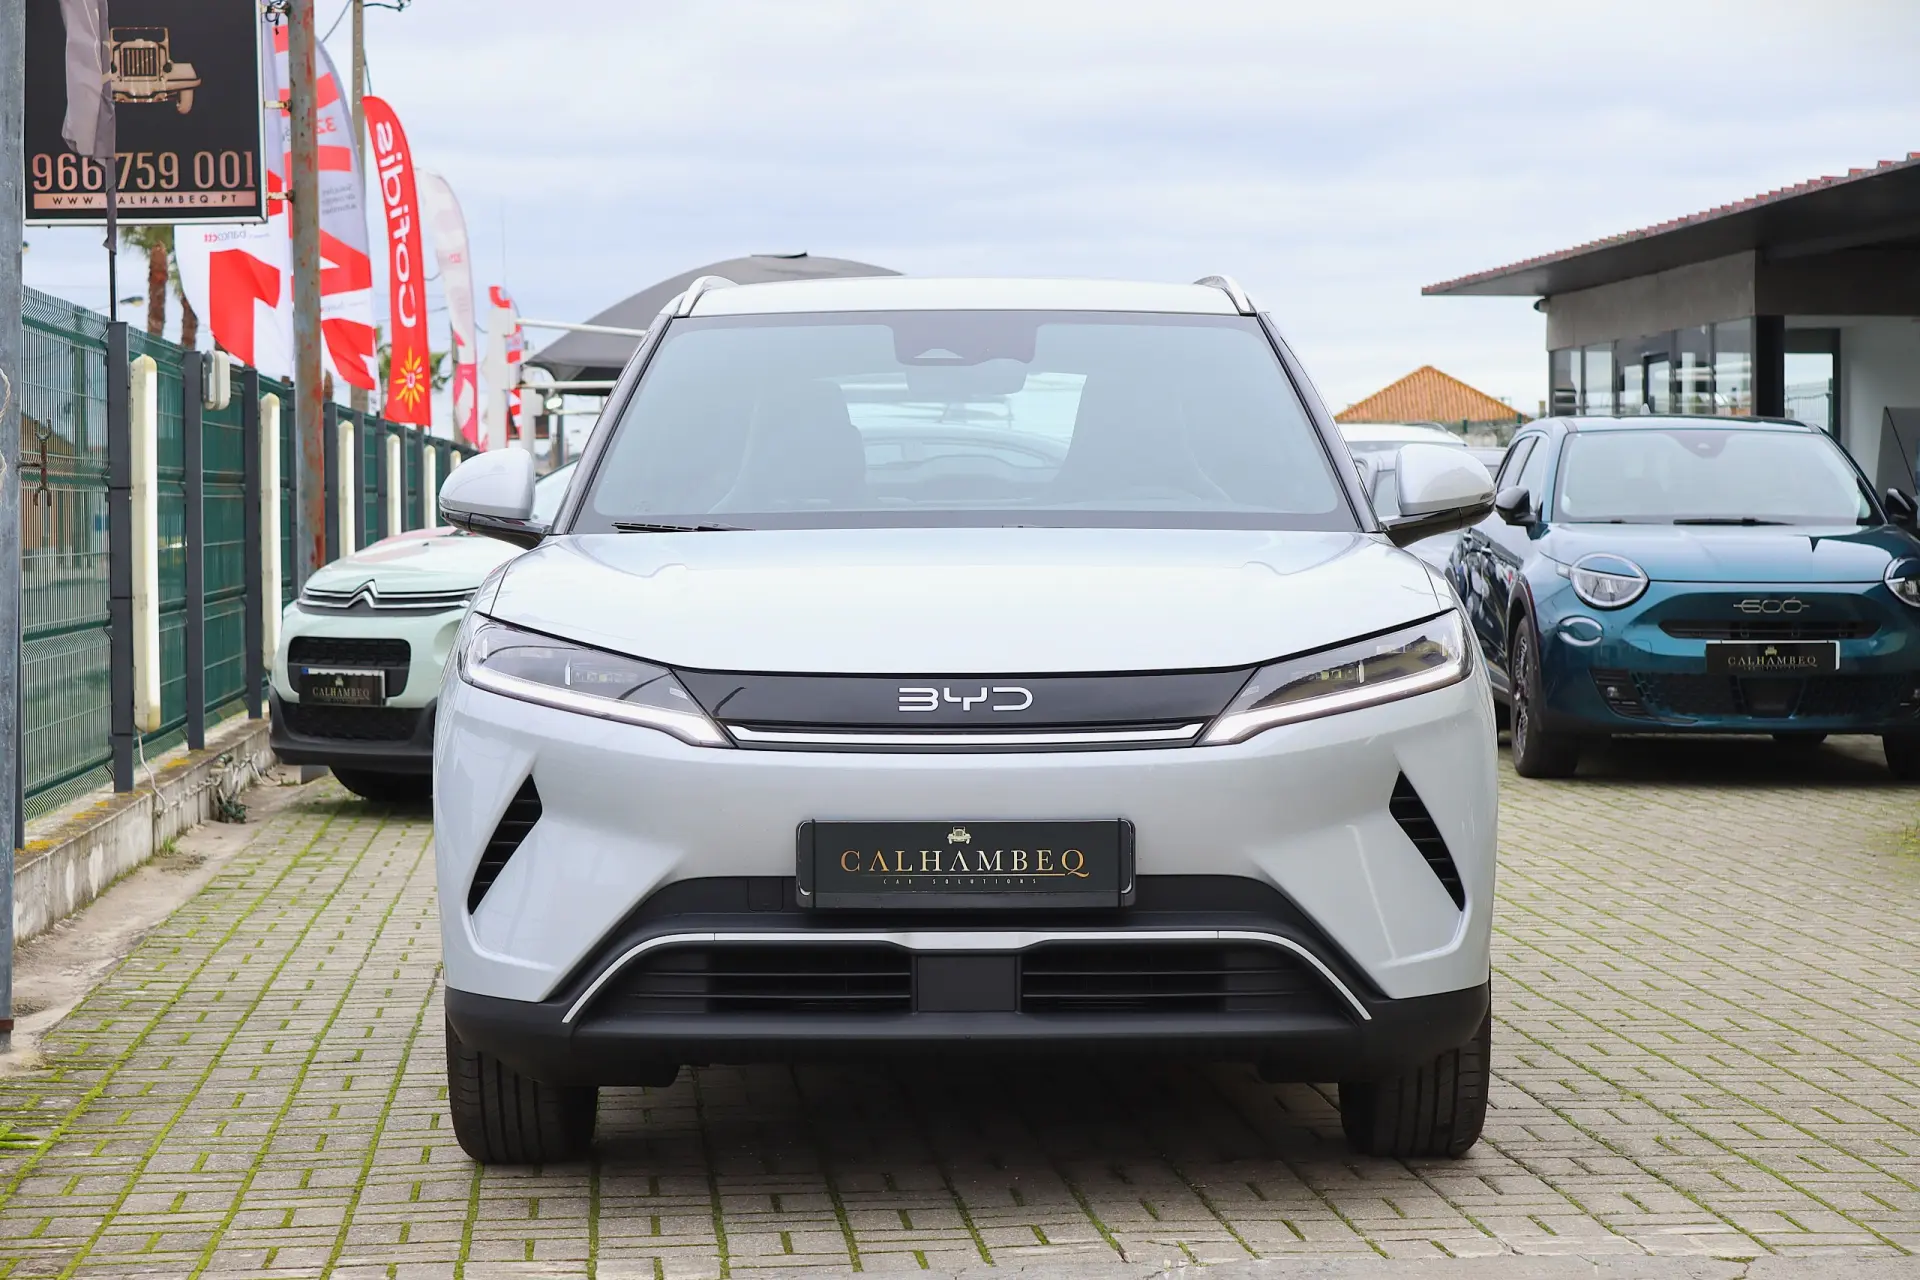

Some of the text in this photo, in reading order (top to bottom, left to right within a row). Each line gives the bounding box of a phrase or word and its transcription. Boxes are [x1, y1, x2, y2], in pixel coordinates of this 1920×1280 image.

[32, 151, 256, 191] 966 759 001
[52, 195, 238, 205] WWW.ALHAMBEQ.PT
[1727, 656, 1818, 668] CALHAMBEQ
[898, 687, 1034, 711] BYD
[840, 849, 1090, 878] CALHAMBEQ
